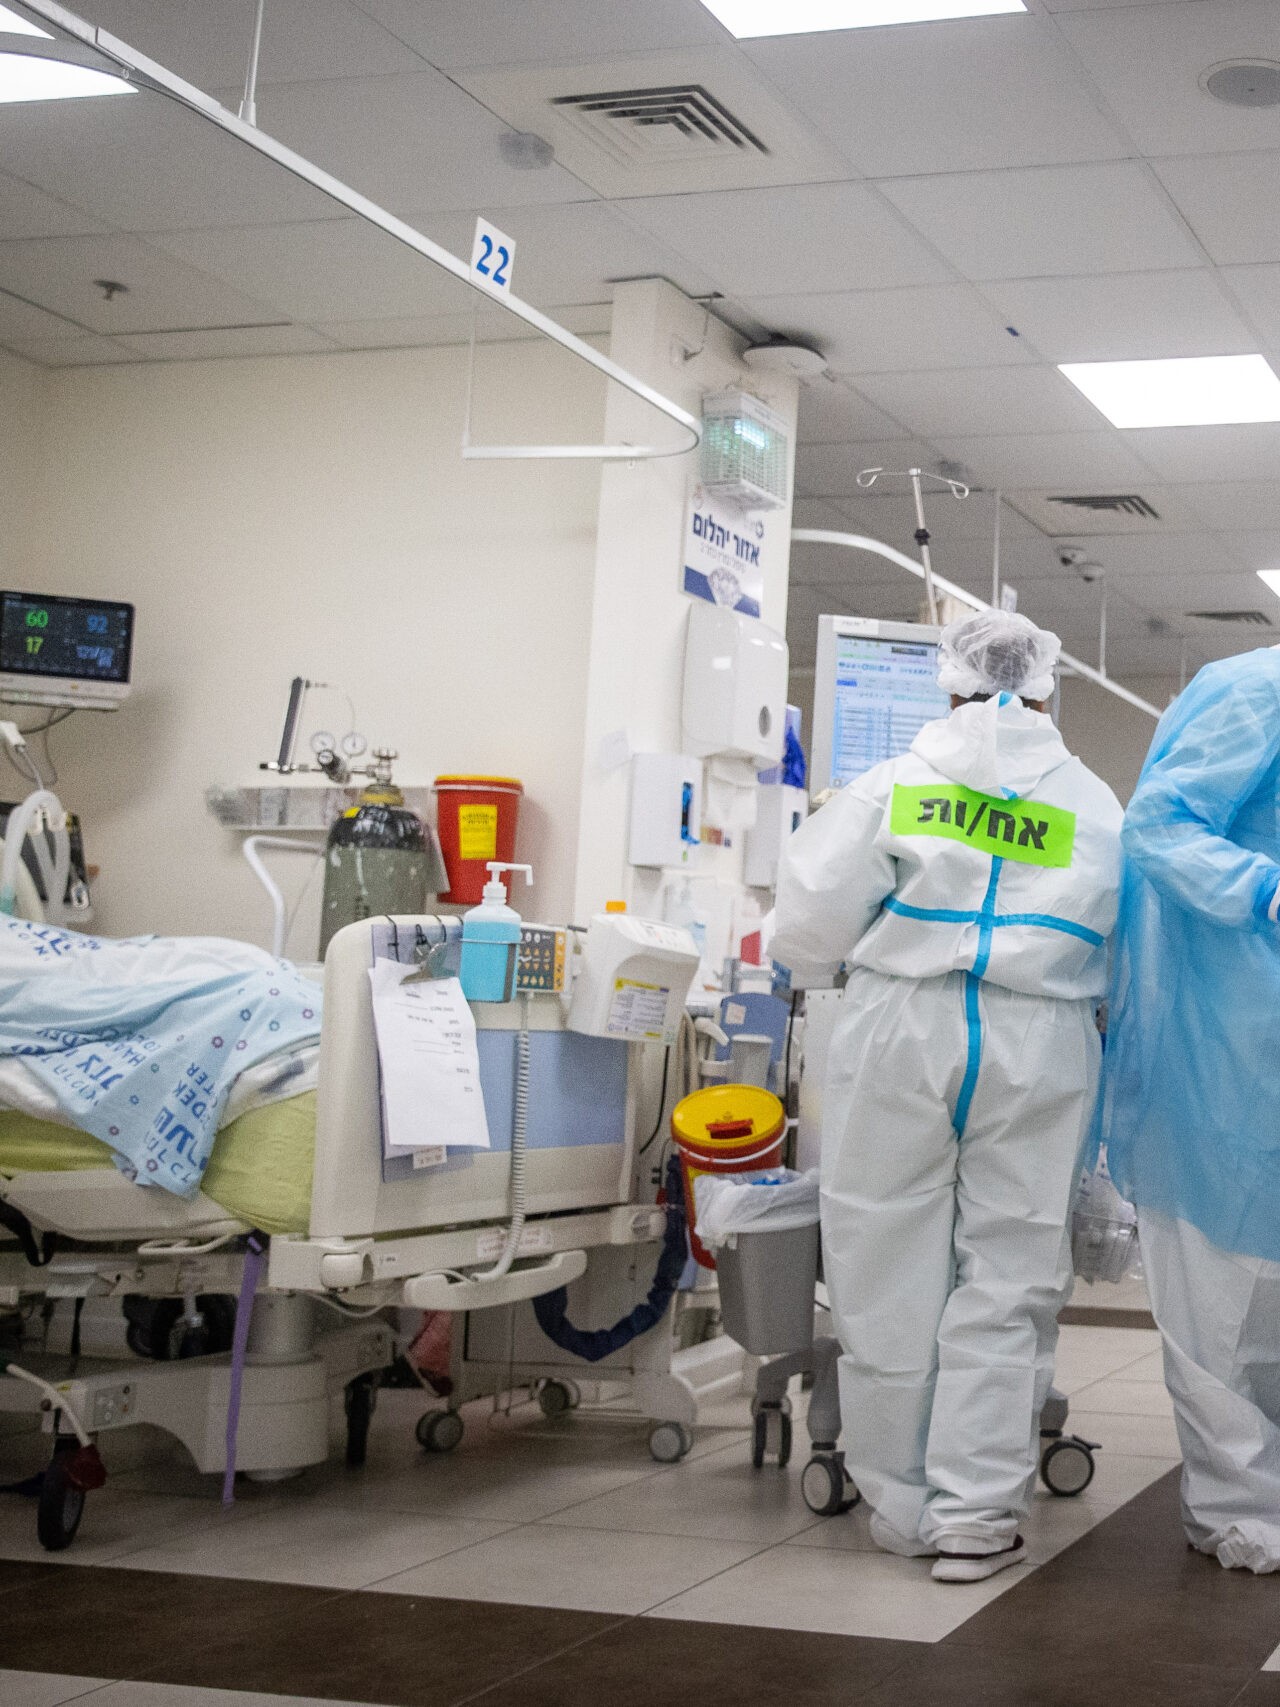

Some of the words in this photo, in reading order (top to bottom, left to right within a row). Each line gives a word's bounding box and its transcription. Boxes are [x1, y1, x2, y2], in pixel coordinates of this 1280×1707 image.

[476, 234, 509, 287] 22
[692, 512, 730, 549] יהלום
[733, 533, 760, 568] אזור
[25, 608, 49, 628] 60
[25, 635, 44, 655] 17
[917, 798, 1049, 851] אח/ות
